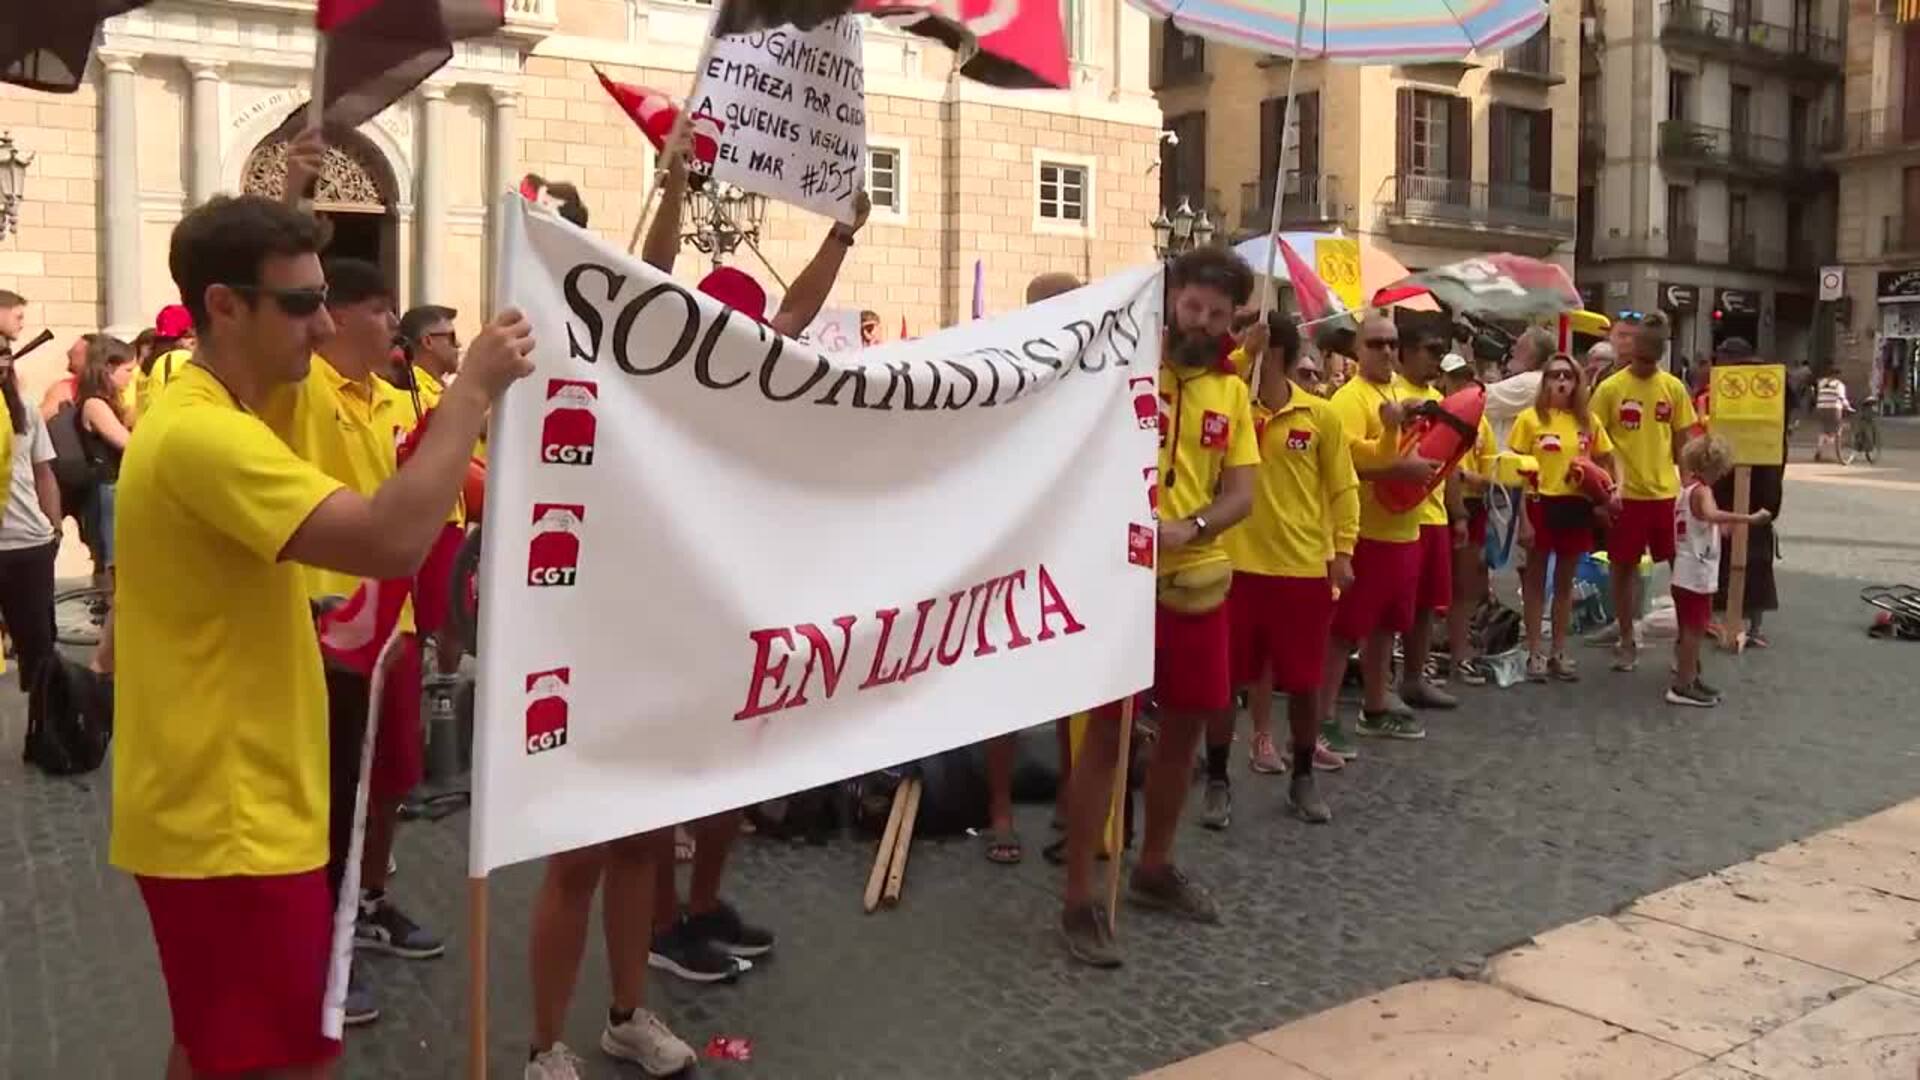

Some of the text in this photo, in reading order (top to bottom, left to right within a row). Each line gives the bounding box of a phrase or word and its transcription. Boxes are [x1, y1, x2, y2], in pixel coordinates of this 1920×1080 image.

[706, 57, 793, 102] EMPIEZA
[699, 96, 713, 116] A
[726, 103, 801, 142] QUIENES
[804, 86, 864, 126] POR CUID
[720, 143, 784, 181] EL MAR
[801, 160, 858, 201] #25J
[543, 442, 593, 465] CGT
[529, 566, 575, 585] CGT
[733, 563, 1085, 721] EN LLUITA
[527, 728, 567, 752] CGT
